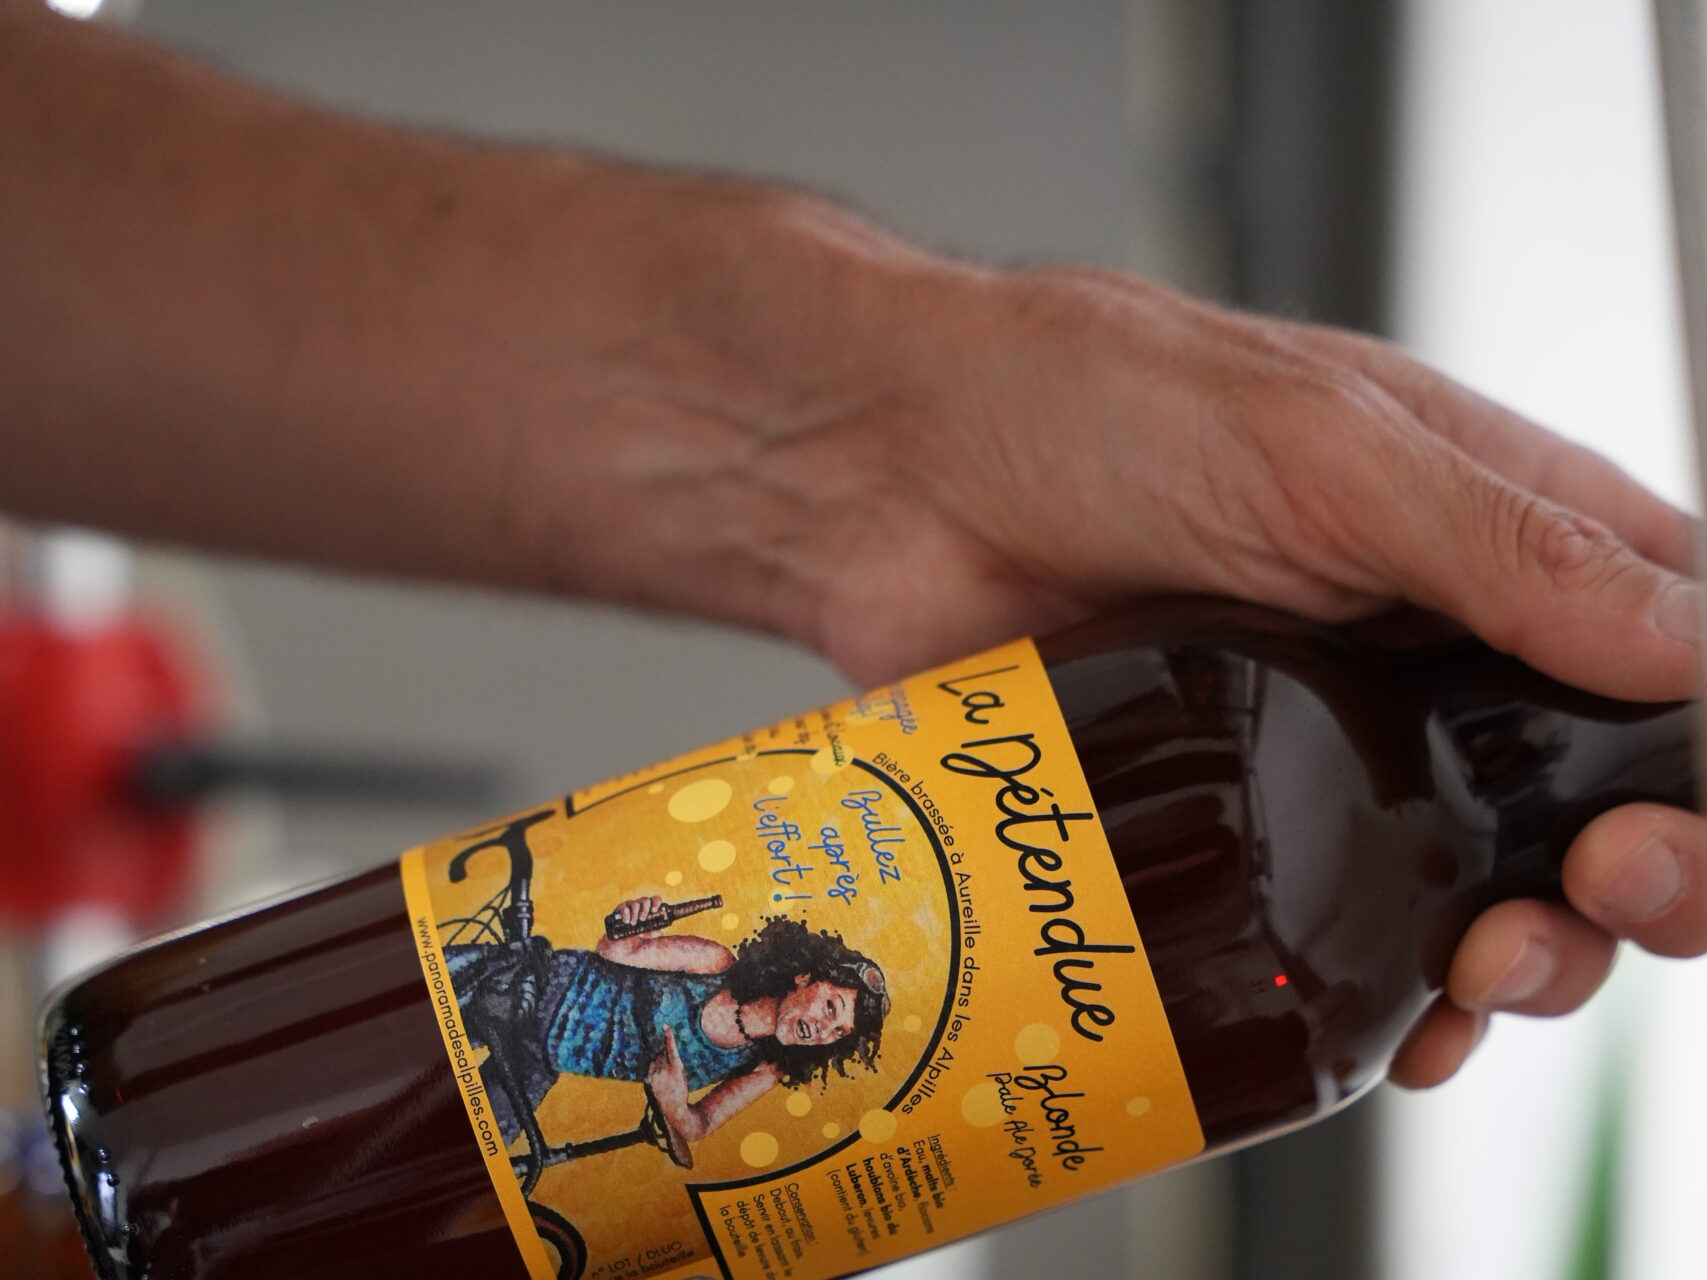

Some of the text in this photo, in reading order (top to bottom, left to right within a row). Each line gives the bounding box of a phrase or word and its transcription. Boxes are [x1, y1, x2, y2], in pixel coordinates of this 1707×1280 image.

[808, 827, 860, 905] après
[841, 790, 906, 884] Bullez
[938, 665, 1135, 1042] La Détendue
[872, 752, 981, 1115] Bière brassée à Aureille dans les Alpilles
[417, 917, 499, 1156] www.panoramadesalpilles.com
[1003, 1120, 1035, 1145] Ale
[1014, 1065, 1104, 1171] Blonde
[863, 1157, 886, 1205] houblons
[880, 1203, 893, 1222] bio
[880, 1153, 900, 1193] d'avoine
[913, 1140, 945, 1209] Eau, malts bio
[719, 1205, 731, 1217] la
[736, 1200, 756, 1230] dépôt
[753, 1193, 770, 1223] Servir
[770, 1188, 792, 1228] Debout,
[608, 1257, 632, 1273] LOT
